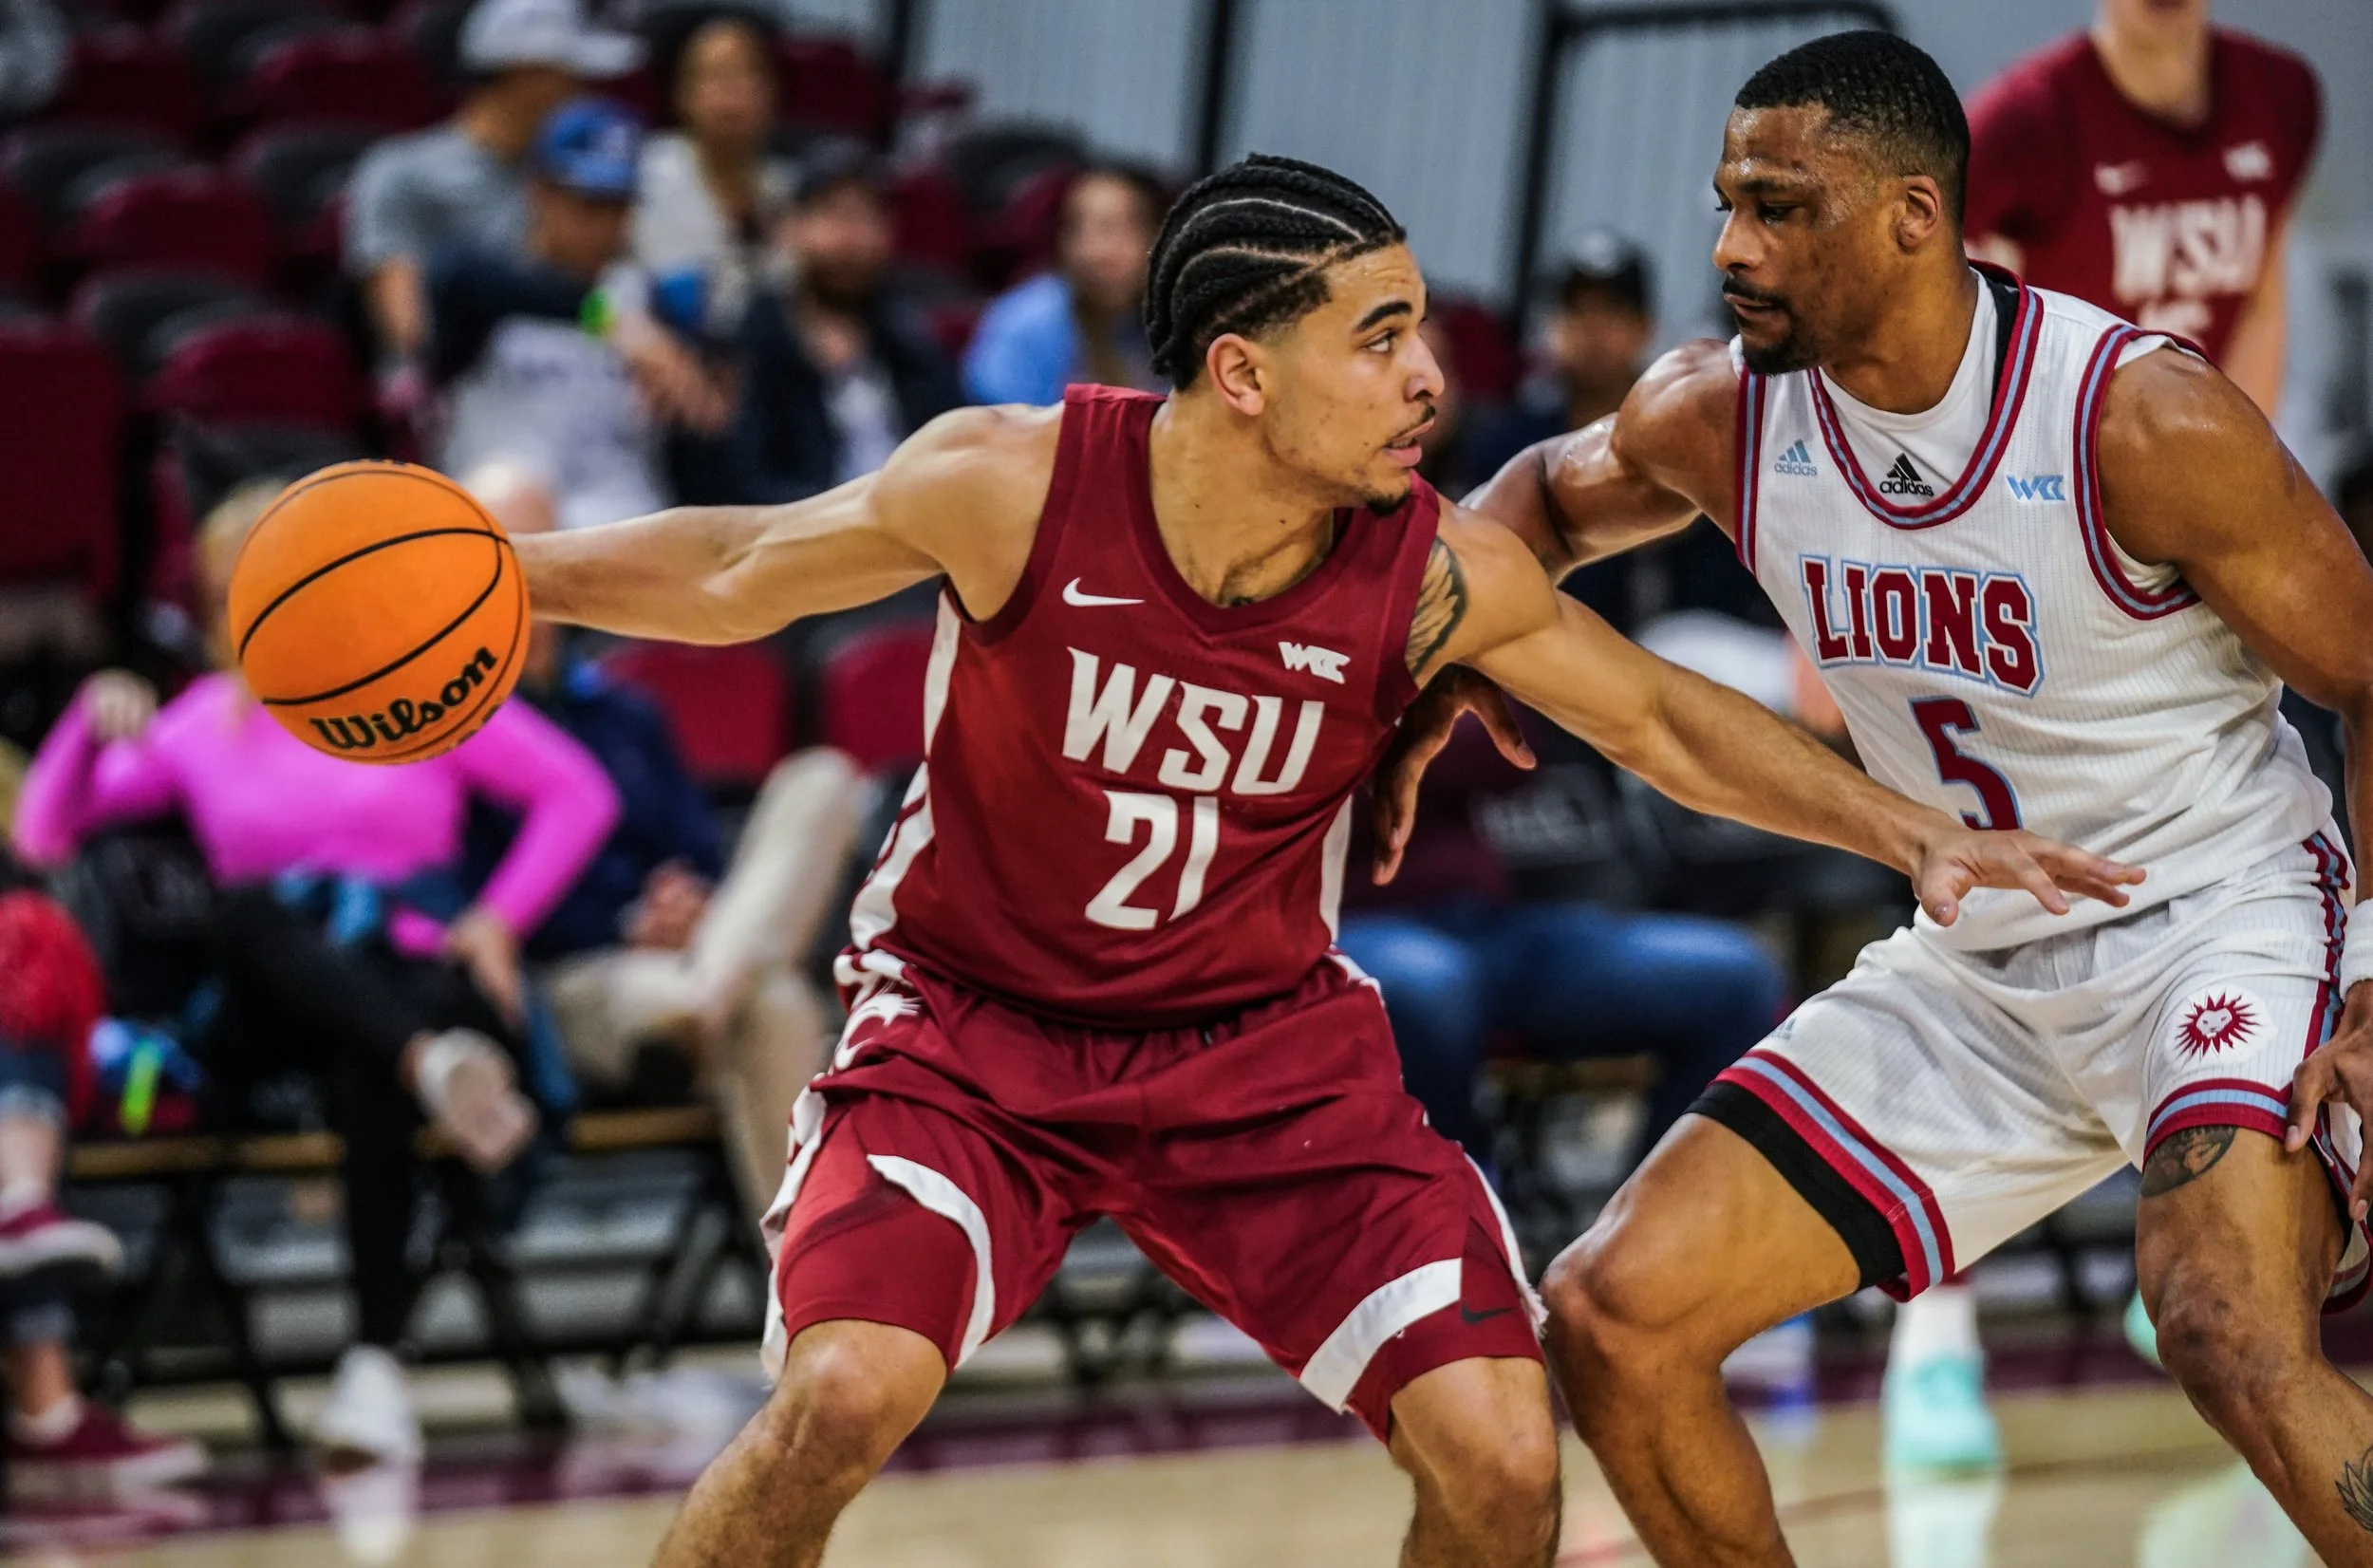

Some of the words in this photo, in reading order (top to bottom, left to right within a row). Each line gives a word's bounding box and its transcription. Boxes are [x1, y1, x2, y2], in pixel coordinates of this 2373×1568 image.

[2109, 195, 2266, 300] WSU
[1774, 458, 1818, 476] adidas
[1879, 477, 1934, 496] adidas
[1799, 553, 2045, 700] LIONS
[308, 646, 498, 750] Wilson
[1062, 646, 1324, 794] WSU
[1908, 694, 2025, 831] 5
[1084, 790, 1218, 930] 21
